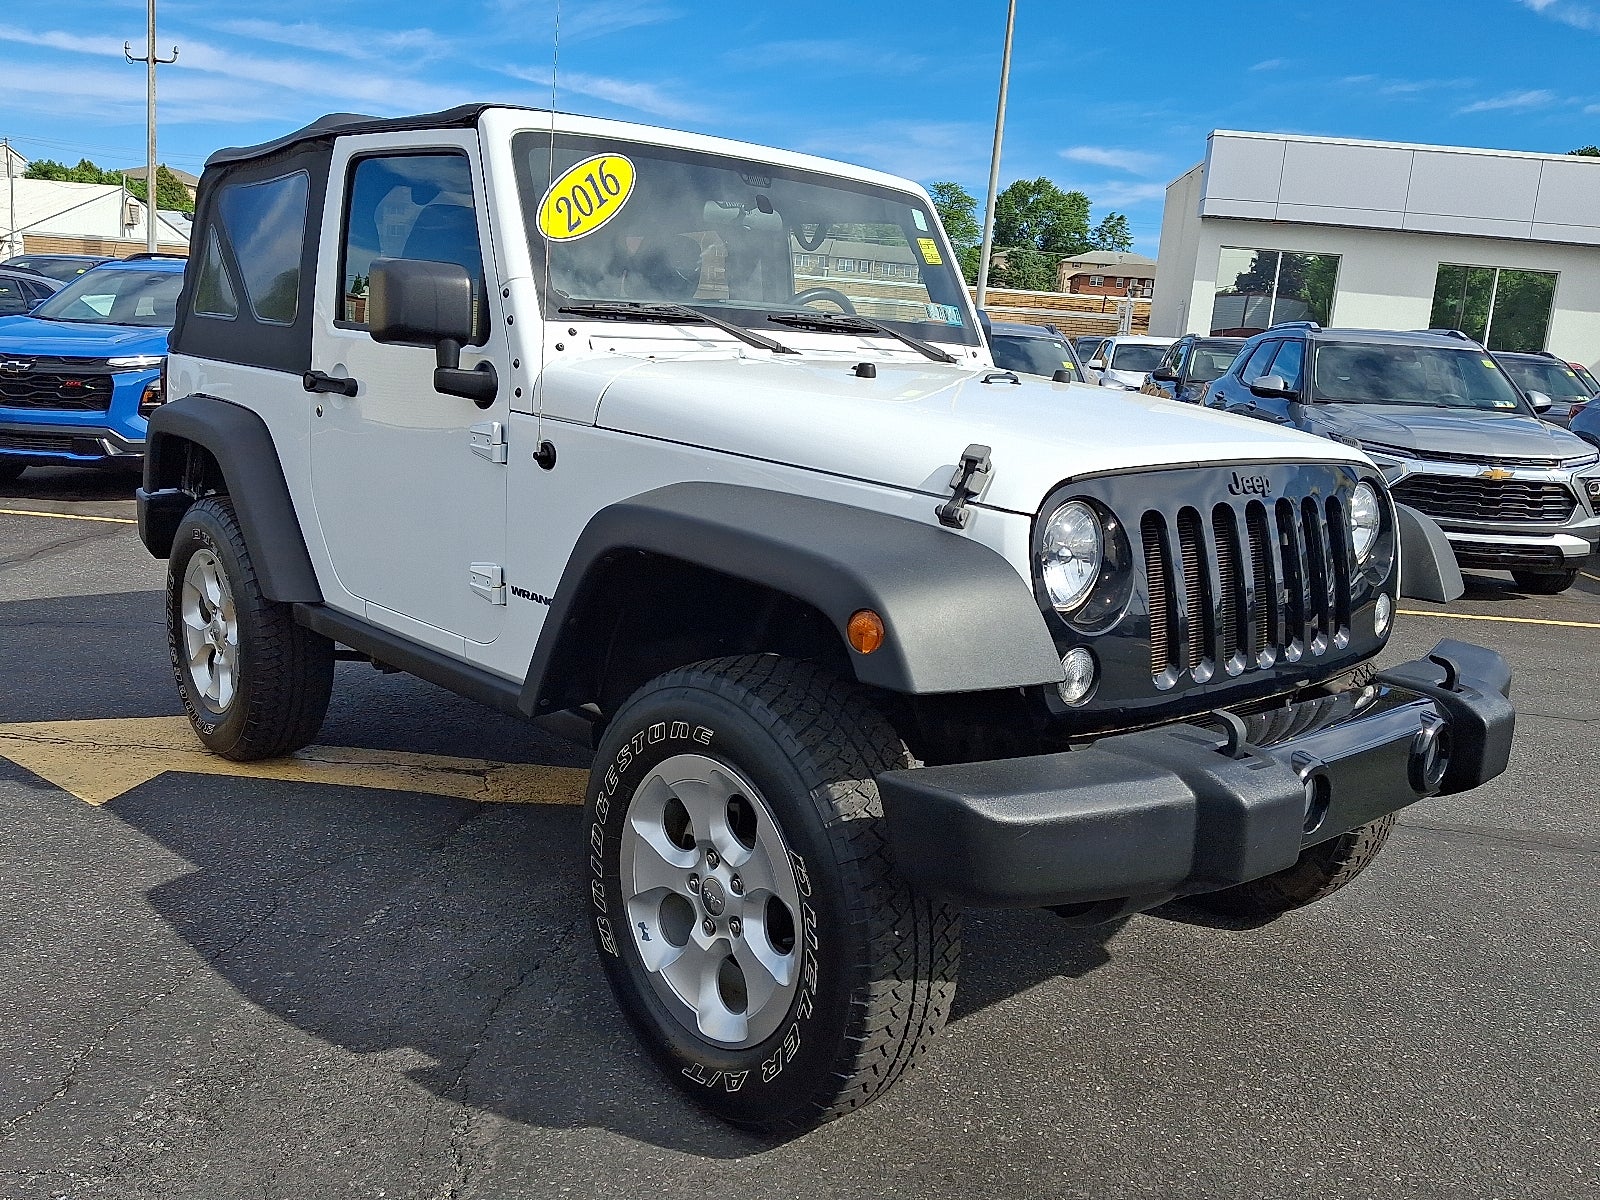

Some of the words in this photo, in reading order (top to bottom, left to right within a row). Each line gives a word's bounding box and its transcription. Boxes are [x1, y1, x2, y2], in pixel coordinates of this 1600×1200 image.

[555, 160, 621, 232] 2016
[1228, 471, 1271, 498] Jeep
[590, 720, 715, 958] BRIDGESTONE
[761, 849, 819, 1083] DUELER
[681, 1062, 749, 1093] A/T
